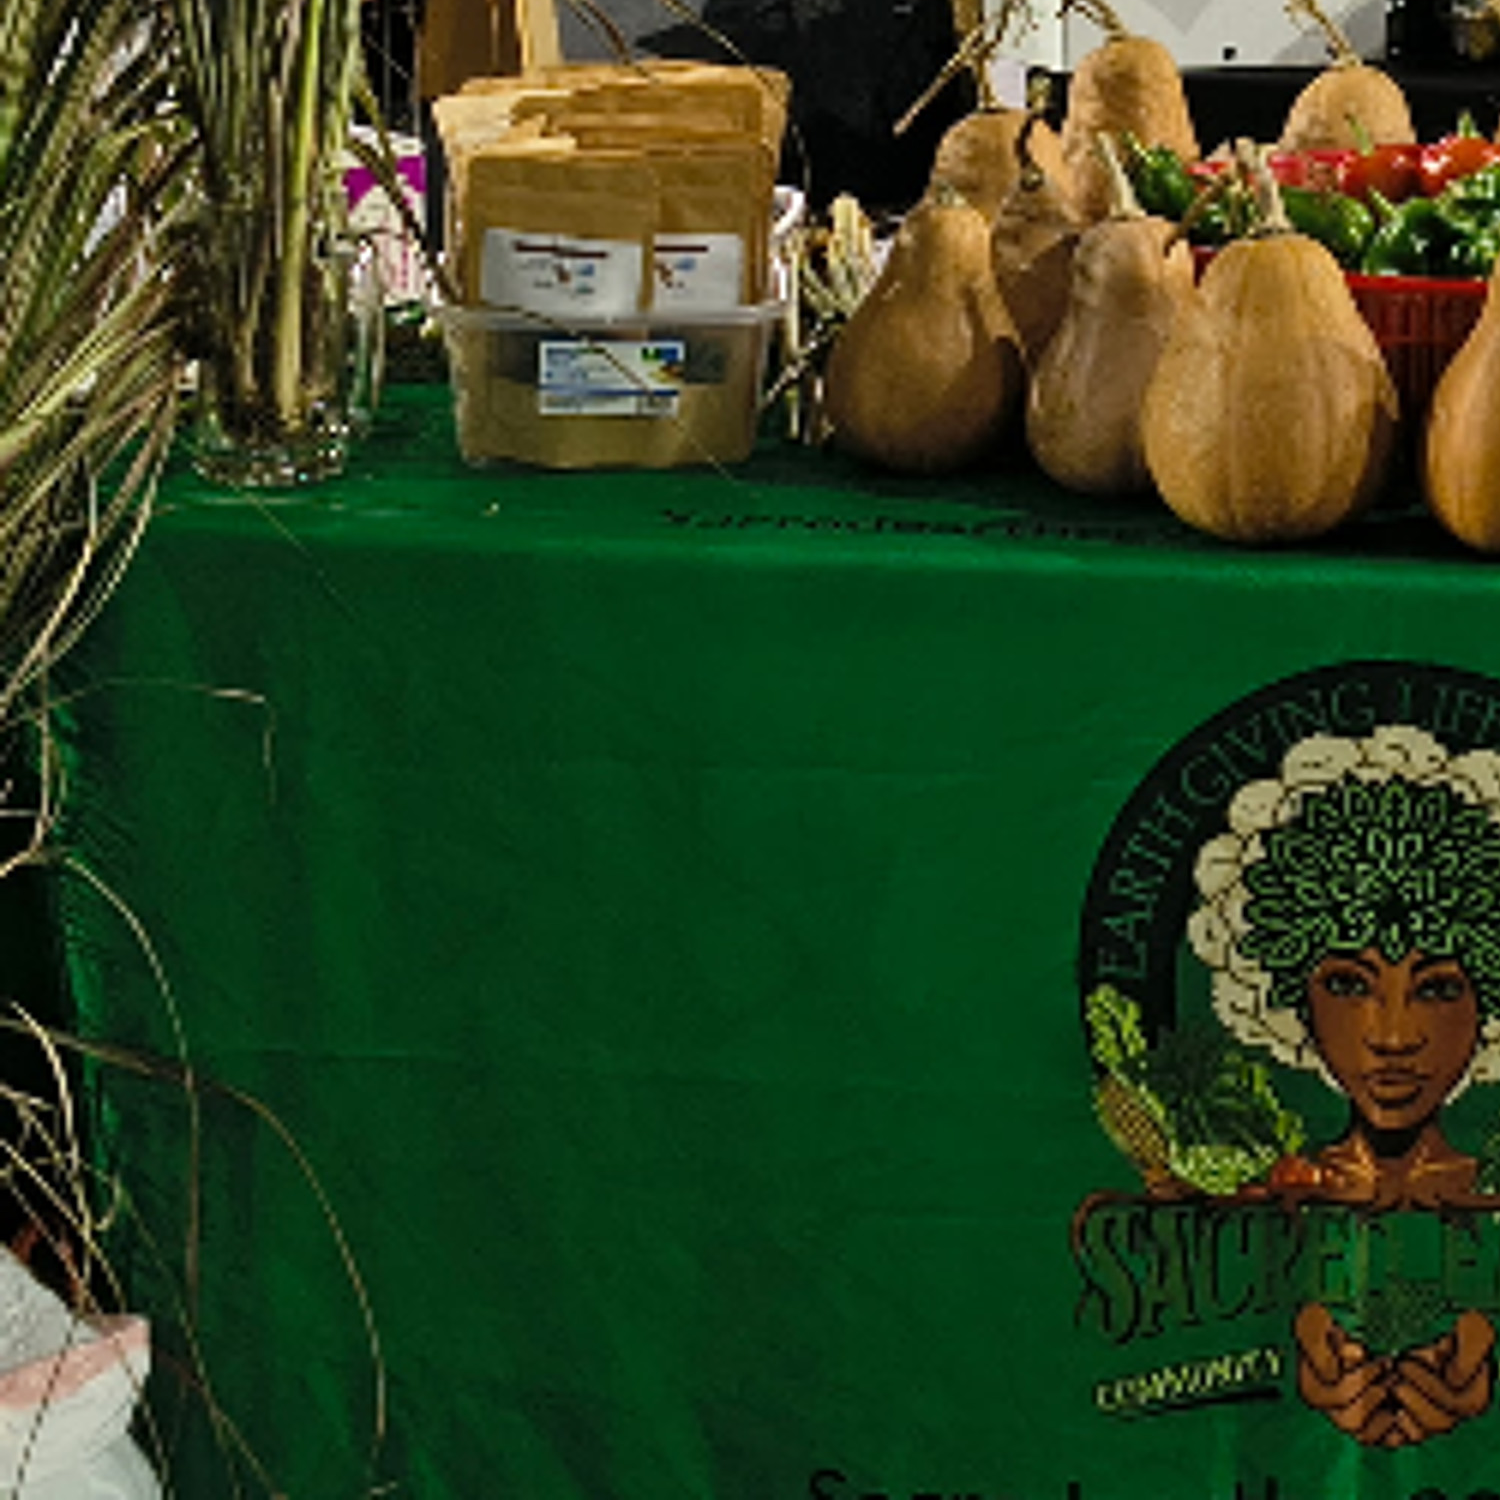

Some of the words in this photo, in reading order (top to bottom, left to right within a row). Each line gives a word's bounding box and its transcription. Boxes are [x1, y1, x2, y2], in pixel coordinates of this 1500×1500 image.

[1100, 797, 1195, 979] EARTH
[1180, 681, 1377, 806] GIVING
[1097, 1347, 1283, 1410] COMMUNITY
